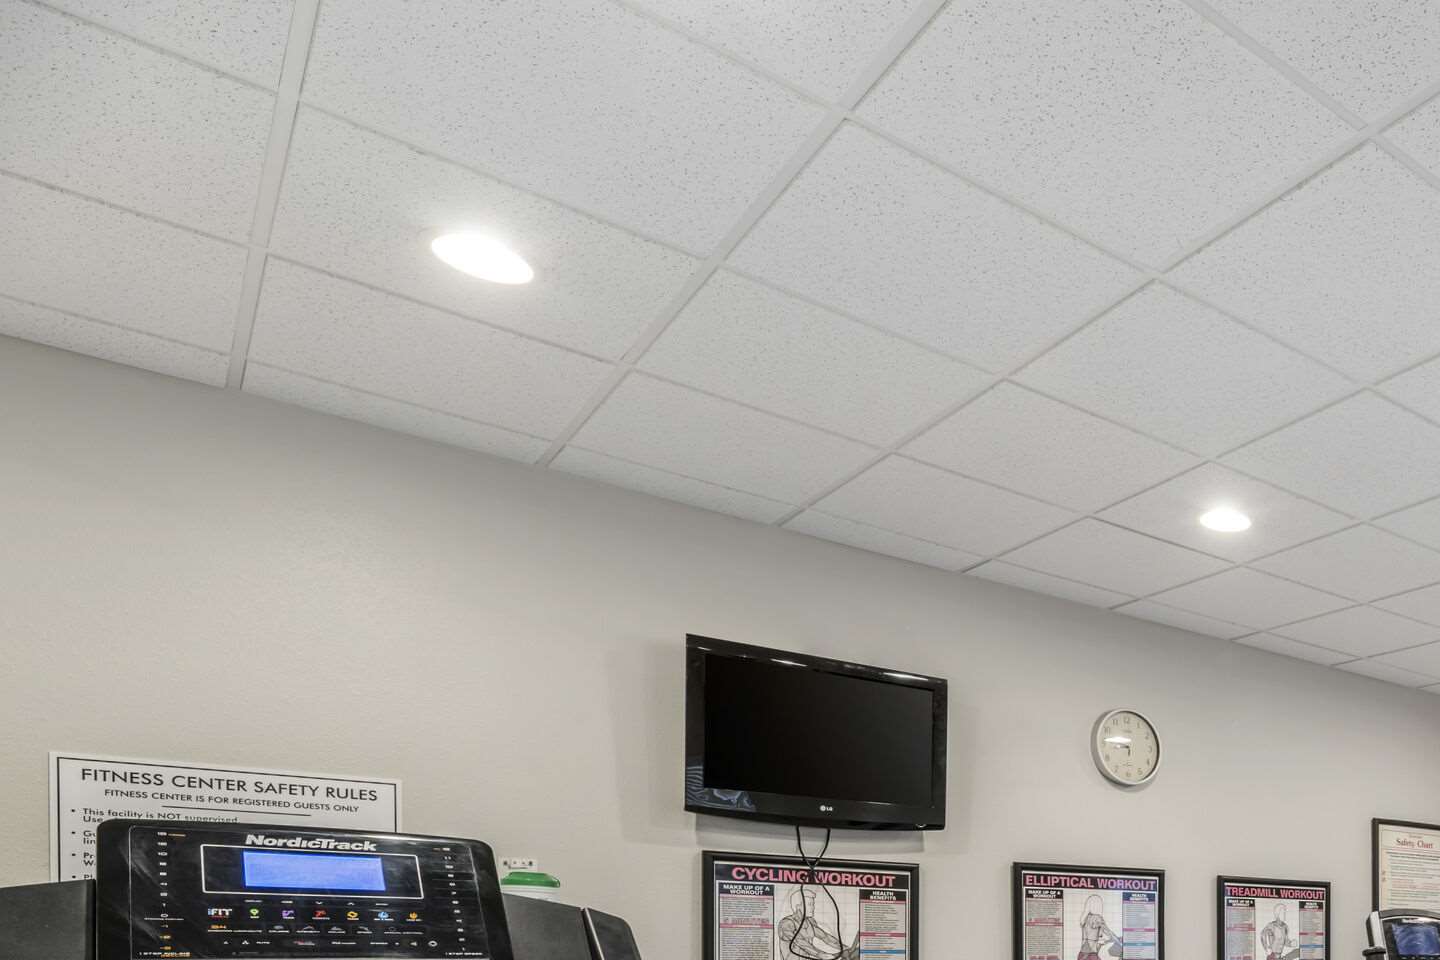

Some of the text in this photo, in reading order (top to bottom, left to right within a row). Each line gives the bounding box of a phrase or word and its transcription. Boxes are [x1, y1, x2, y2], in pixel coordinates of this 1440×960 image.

[81, 768, 378, 801] FITNESS CENTER SAFETY RULES
[104, 789, 360, 813] FITNESS CENTER IS FOR REGISTERED GUESTS ONLY
[83, 808, 104, 816] This
[107, 809, 143, 819] facility
[145, 811, 154, 819] is
[157, 812, 182, 820] NOT
[245, 834, 377, 851] NordicTrack
[1396, 837, 1434, 849] Safety Chart
[731, 866, 896, 888] CYCLING WORKOUT
[1025, 875, 1156, 890] ELLIPTICAL WORKOUT
[1226, 886, 1324, 900] TREADMILL WORKOUT
